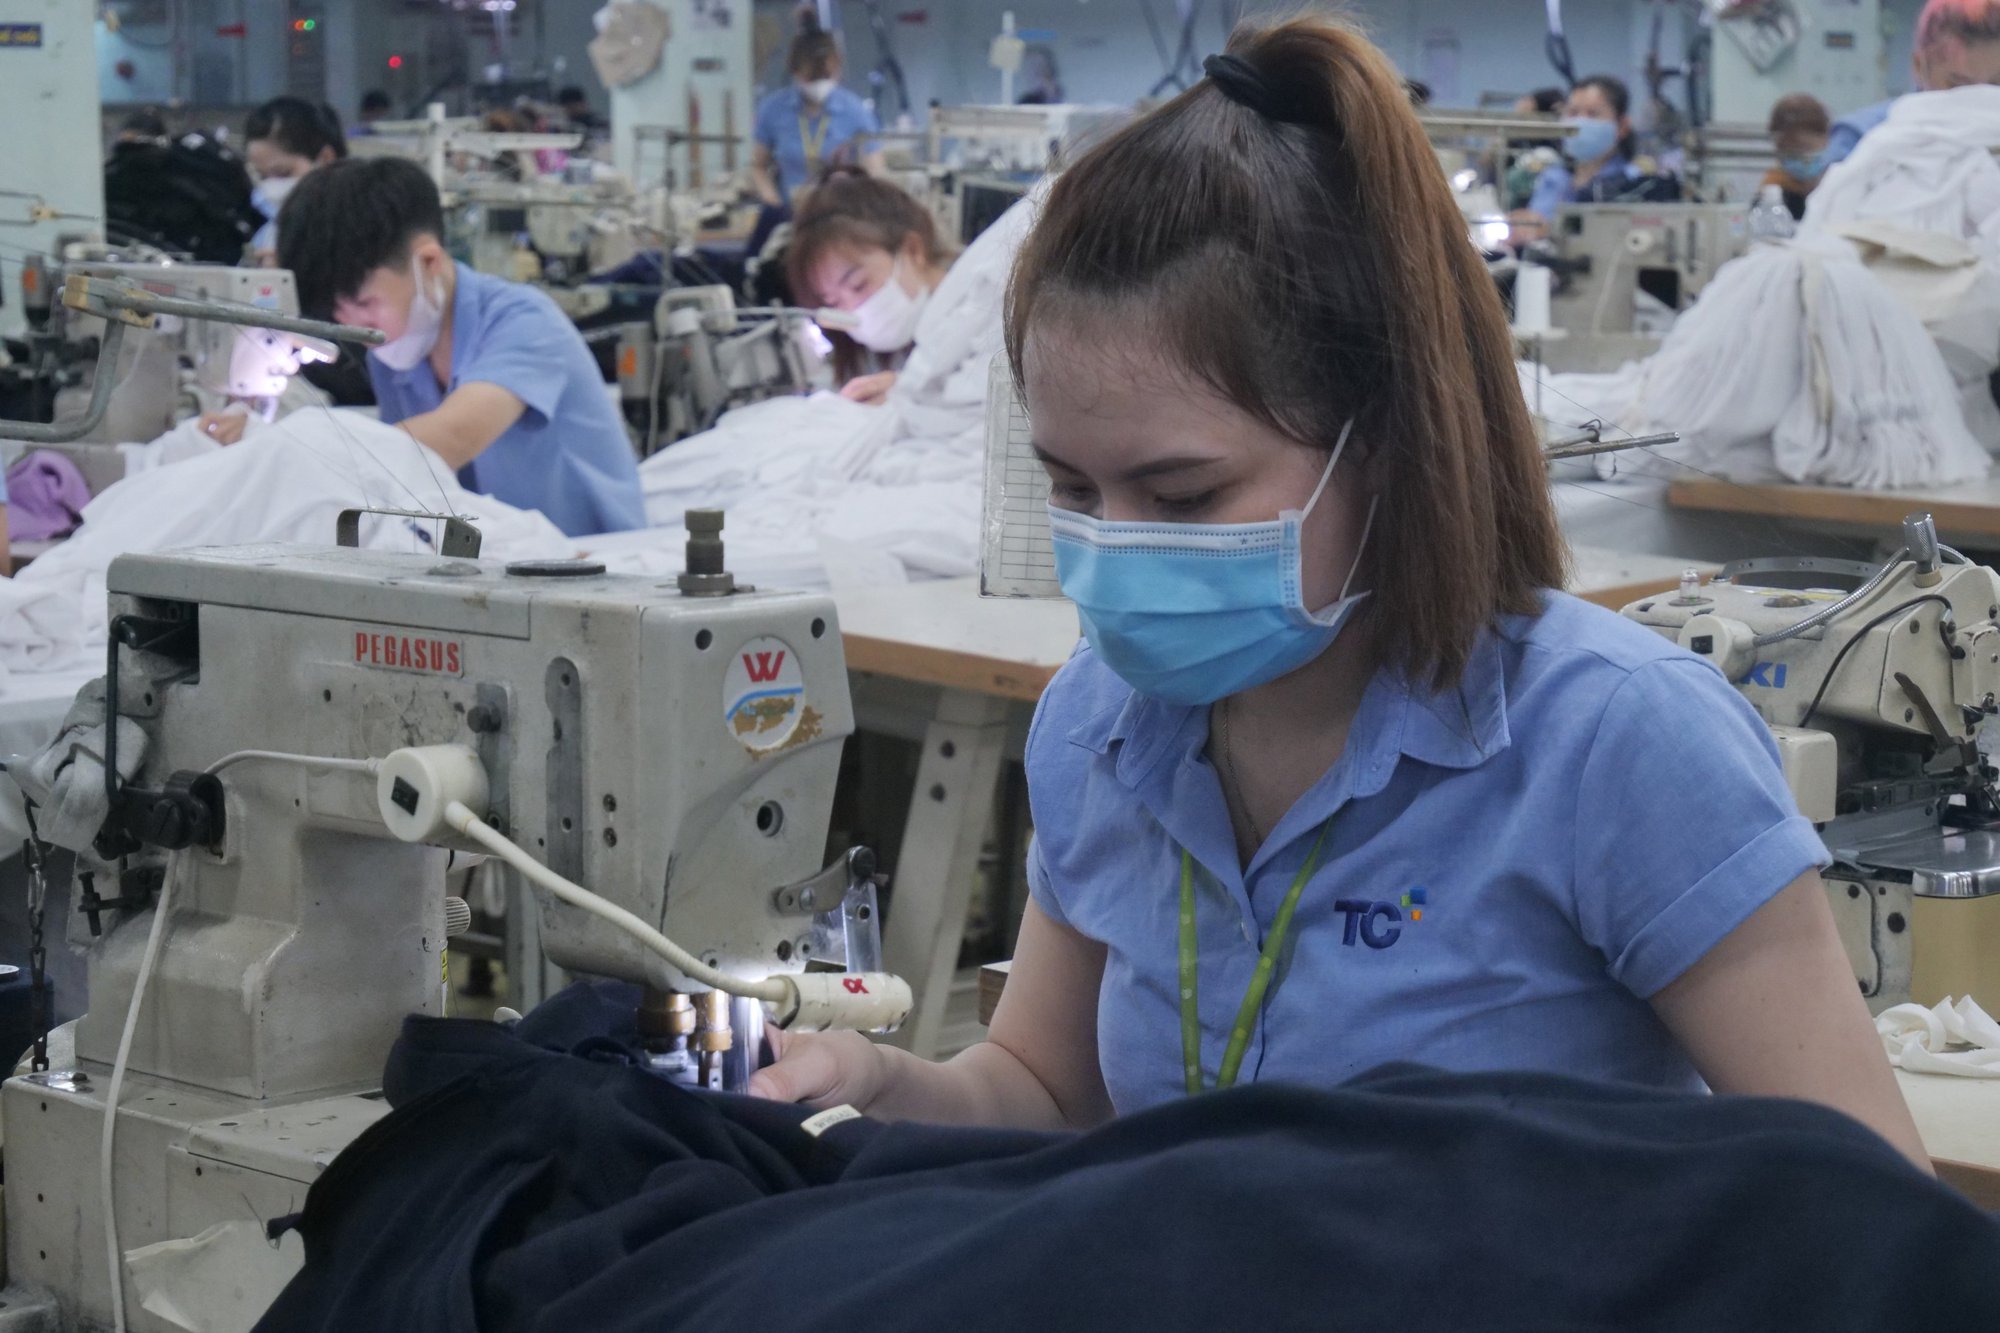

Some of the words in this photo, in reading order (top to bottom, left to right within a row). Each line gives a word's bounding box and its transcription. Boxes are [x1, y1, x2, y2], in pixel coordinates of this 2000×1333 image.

[356, 632, 460, 673] PEGASUS
[742, 651, 786, 683] W
[1741, 662, 1788, 689] KI
[1334, 899, 1402, 950] TC
